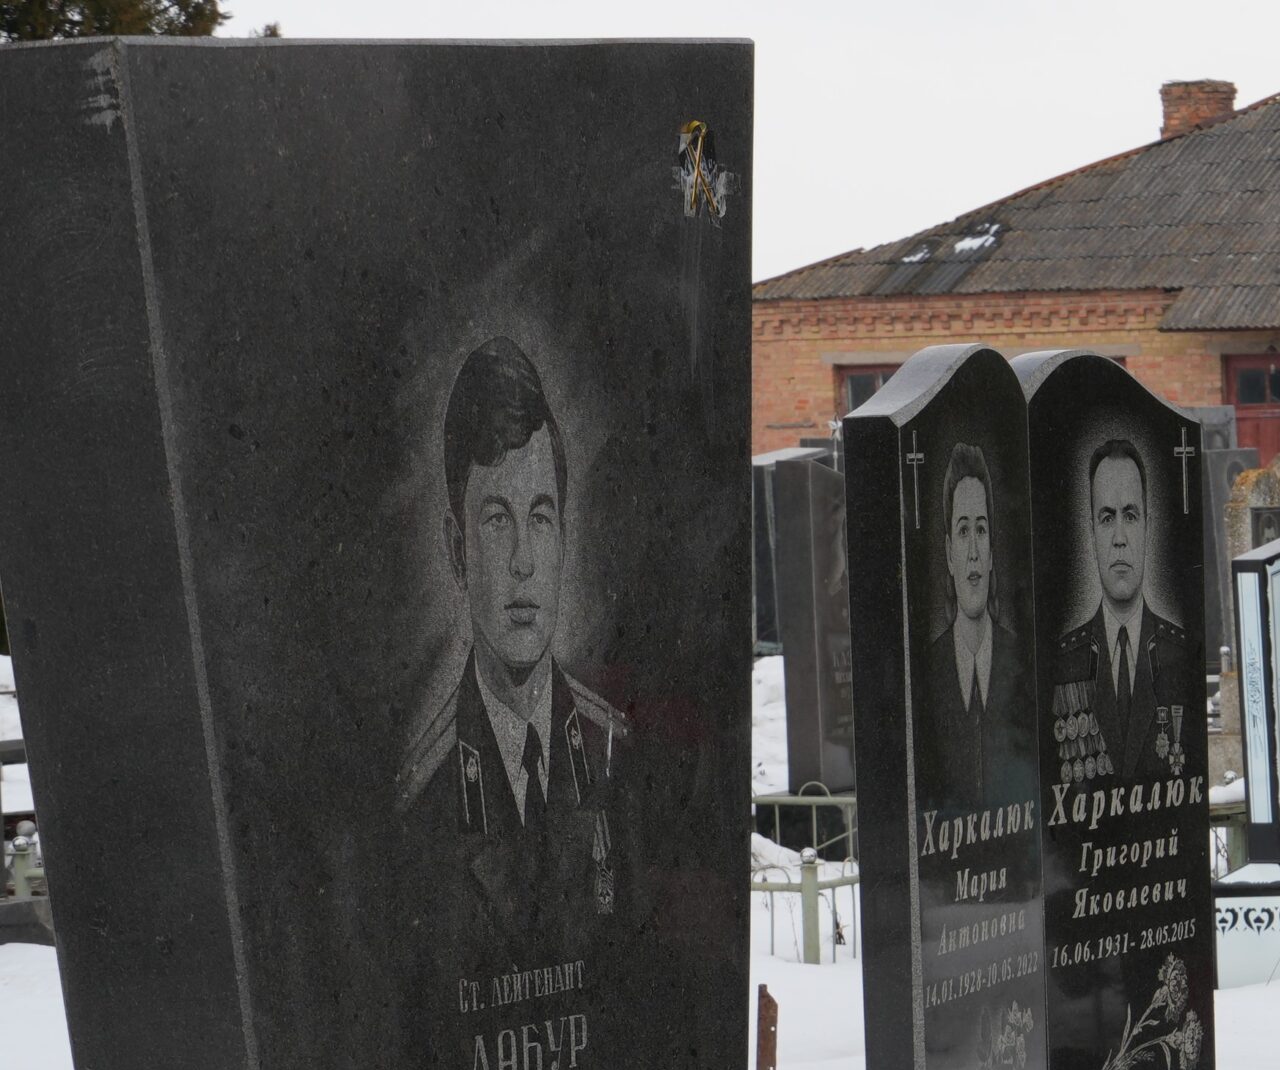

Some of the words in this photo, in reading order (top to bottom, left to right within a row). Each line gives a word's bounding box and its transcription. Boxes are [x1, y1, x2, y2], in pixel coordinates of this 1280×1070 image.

[1047, 775, 1204, 831] Харкалюк
[921, 799, 1035, 860] Харкалюк
[1078, 828, 1179, 878] Григорий
[954, 866, 1007, 902] Мария
[1072, 876, 1187, 919] Яковлевич
[937, 908, 1026, 957] Антоновна
[1140, 918, 1197, 950] 28.05.2015
[491, 959, 586, 1008] ЛЕЙТЕНАНТ
